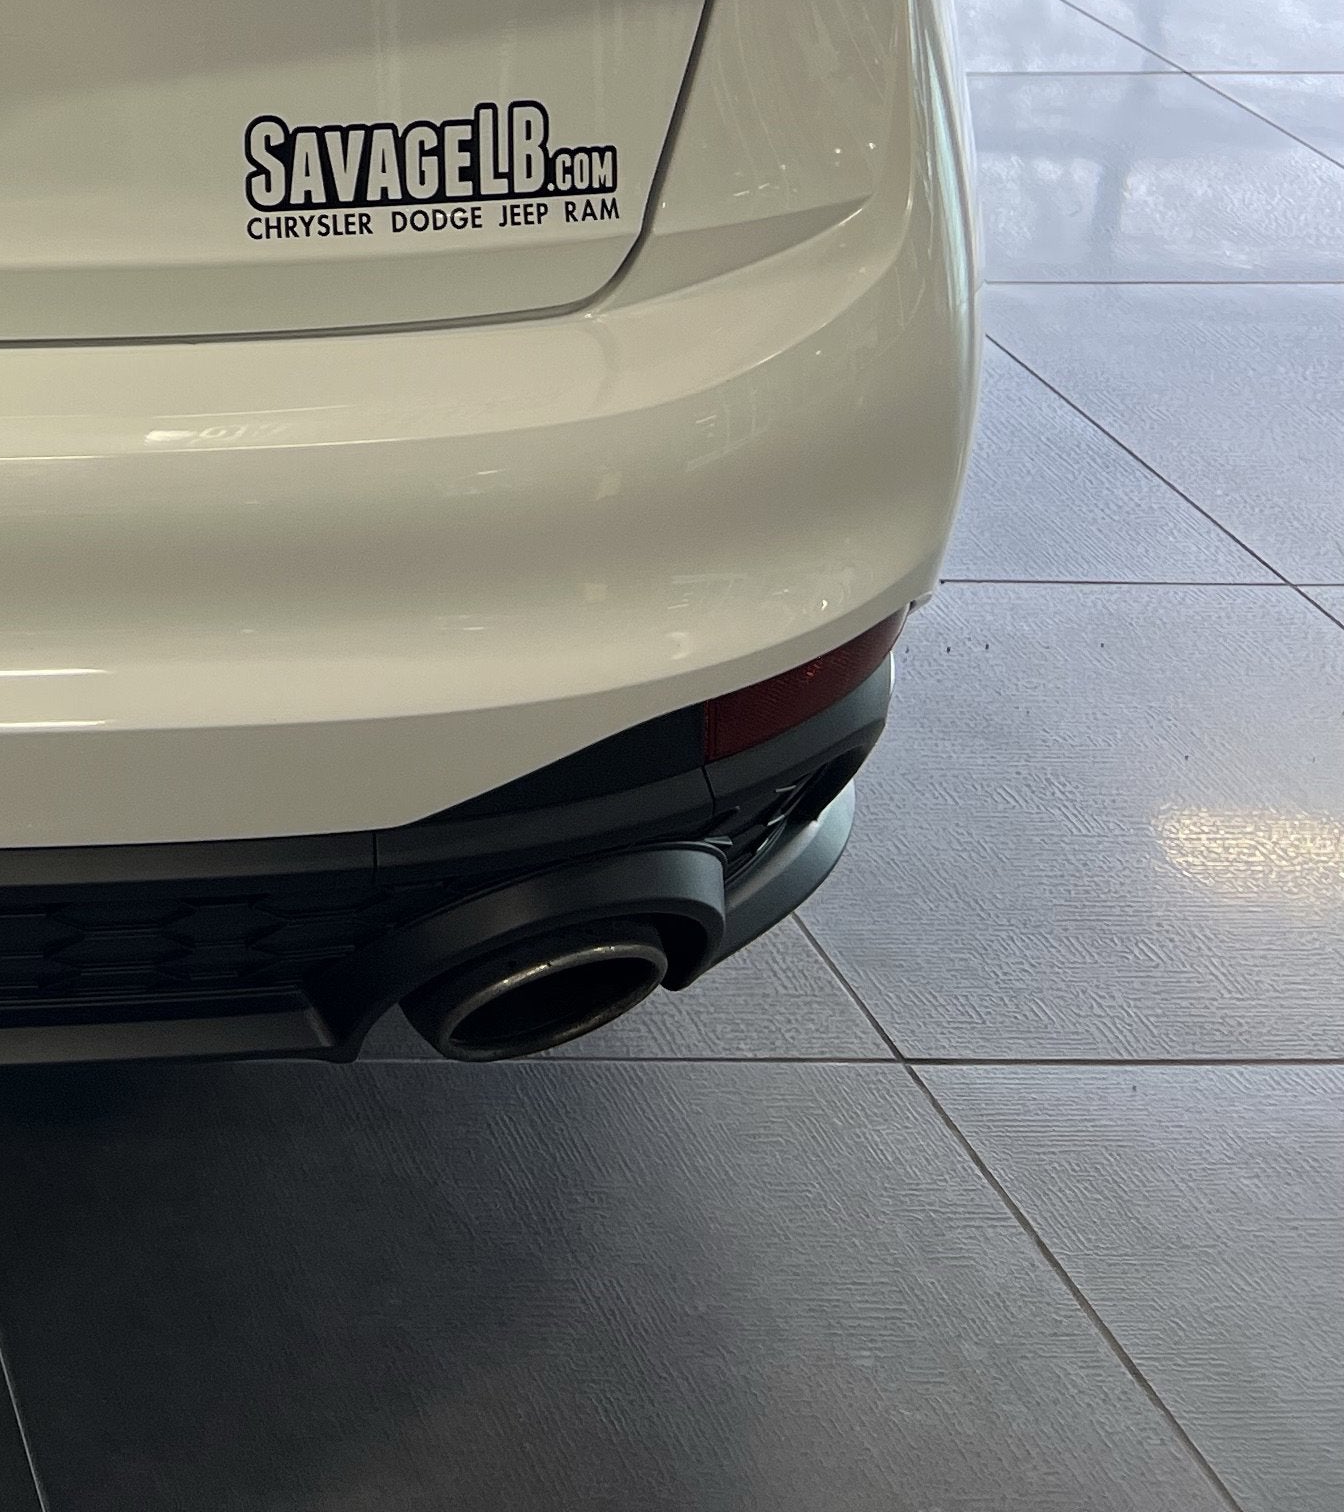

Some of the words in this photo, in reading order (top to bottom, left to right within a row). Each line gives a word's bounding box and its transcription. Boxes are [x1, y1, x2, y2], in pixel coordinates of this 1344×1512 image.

[246, 213, 374, 240] CHRYSLER
[391, 206, 483, 233] DODGE
[498, 203, 549, 228] JEEP
[564, 197, 620, 223] RAM
